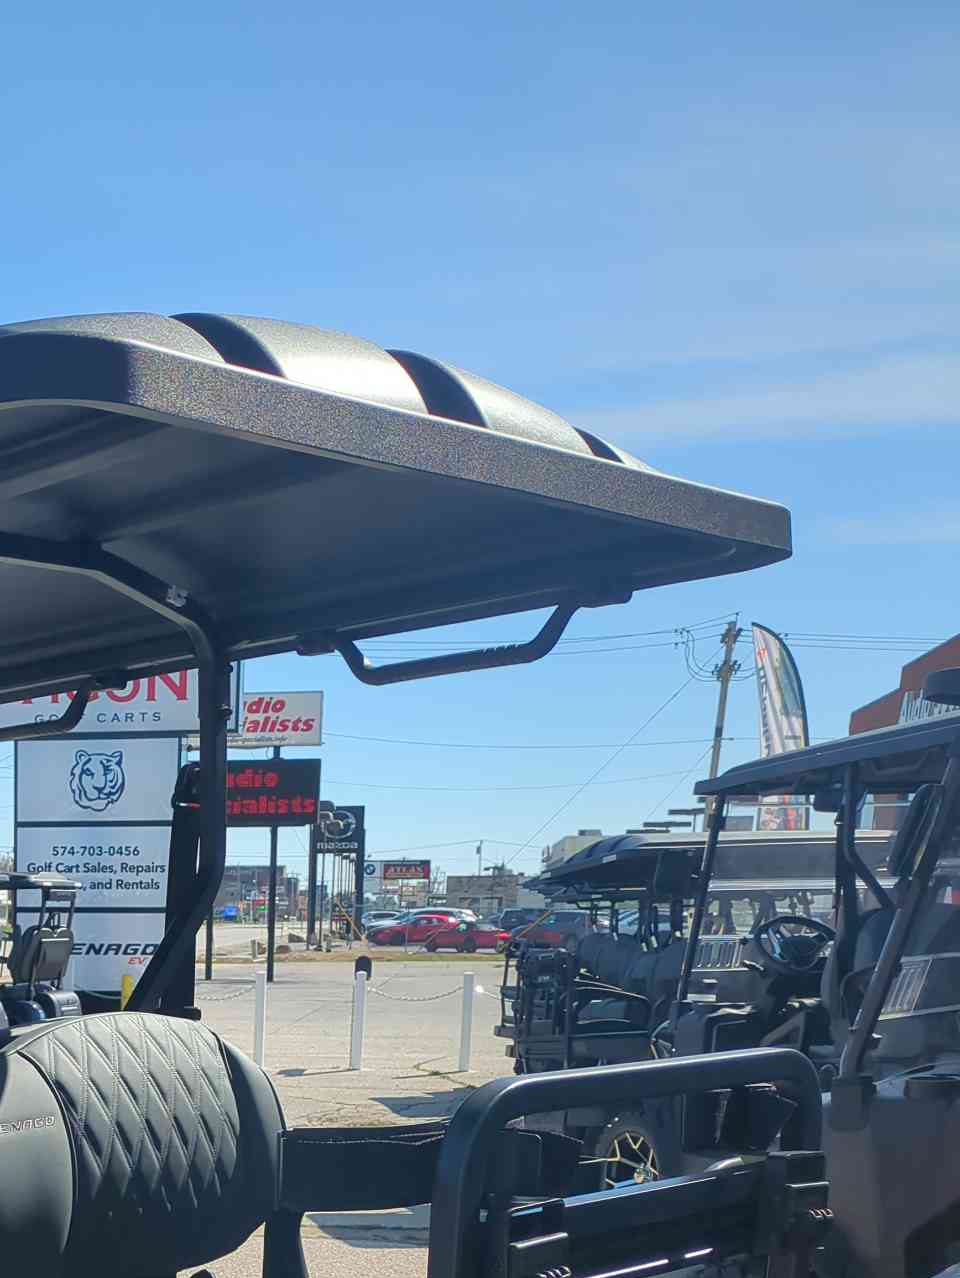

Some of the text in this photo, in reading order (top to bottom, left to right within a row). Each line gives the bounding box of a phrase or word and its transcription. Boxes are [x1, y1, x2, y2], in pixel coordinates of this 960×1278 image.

[97, 711, 161, 723] CARTS
[52, 846, 140, 857] 574-703-0456
[27, 862, 166, 876] Golf Cart Sales, Repairs
[90, 879, 112, 890] and
[116, 879, 160, 890] Rentals
[70, 943, 160, 956] ENAGO
[128, 957, 146, 965] EV
